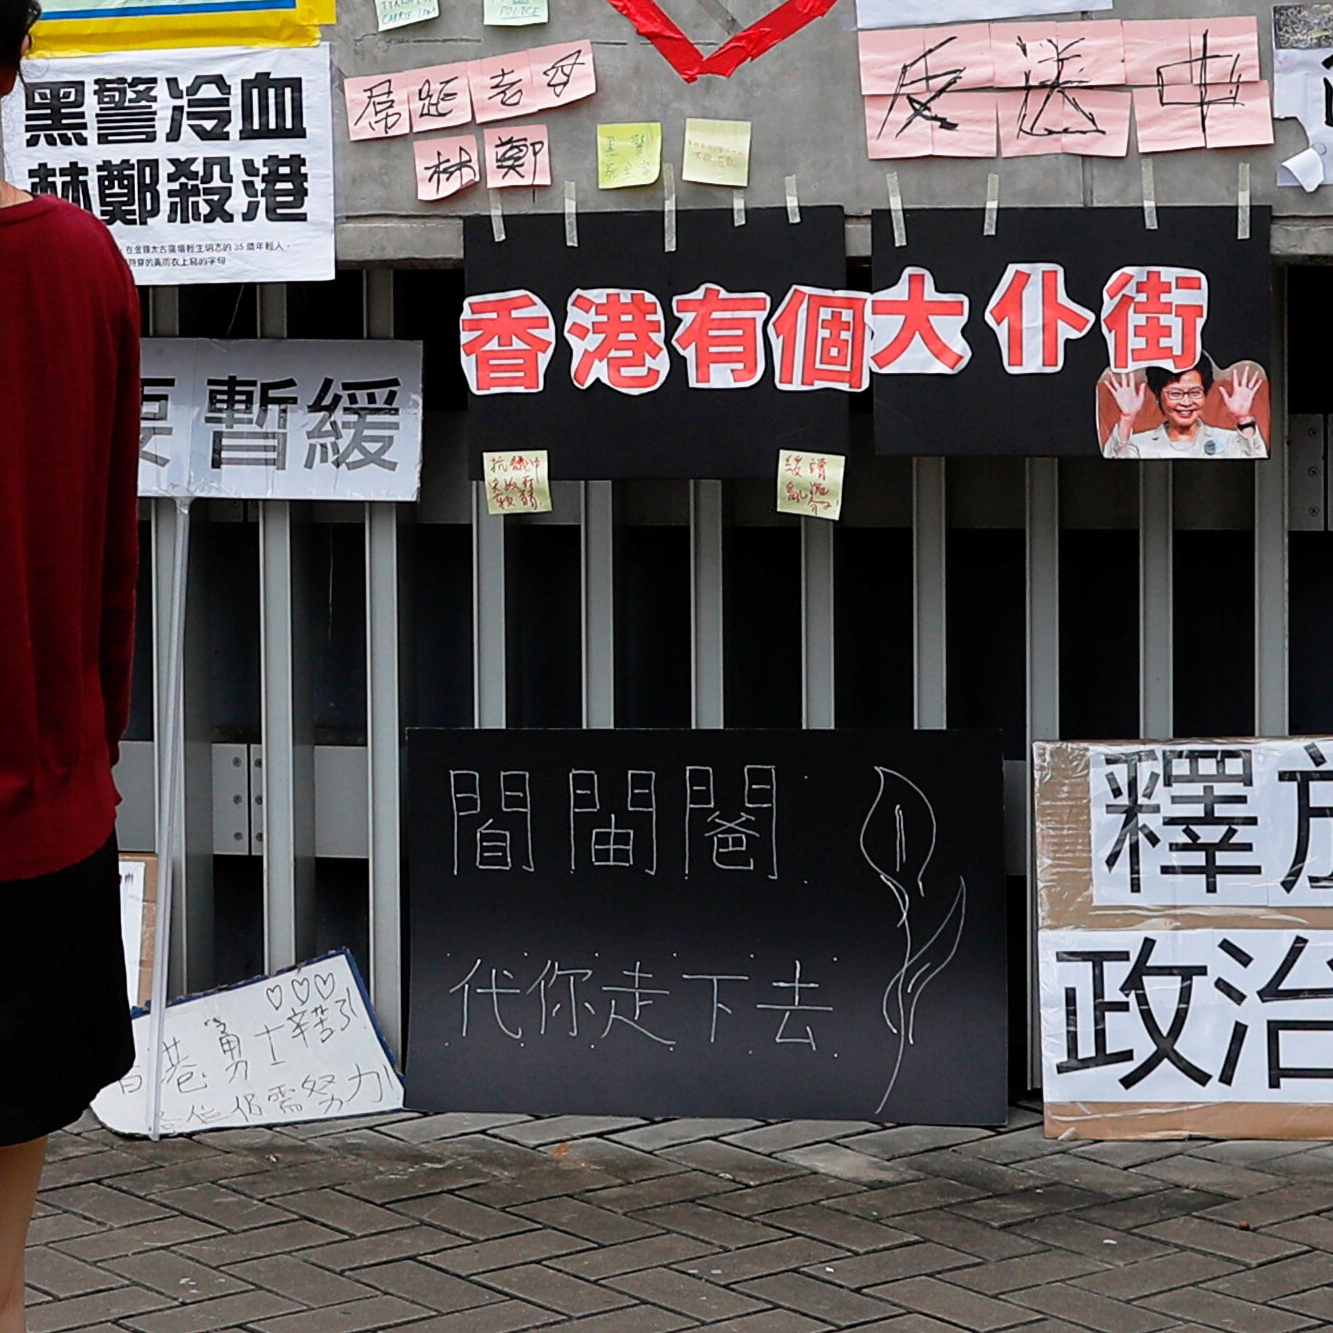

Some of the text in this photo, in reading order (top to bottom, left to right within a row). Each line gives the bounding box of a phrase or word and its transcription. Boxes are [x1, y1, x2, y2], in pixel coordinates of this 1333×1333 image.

[24, 72, 308, 148] 黑警冷血
[876, 29, 1245, 140] 反送中
[26, 154, 309, 227] 林鄭殺港
[423, 136, 544, 203] 林鄭
[461, 269, 1205, 391] 香港有個大仆街
[449, 959, 835, 1051] 代你走下去
